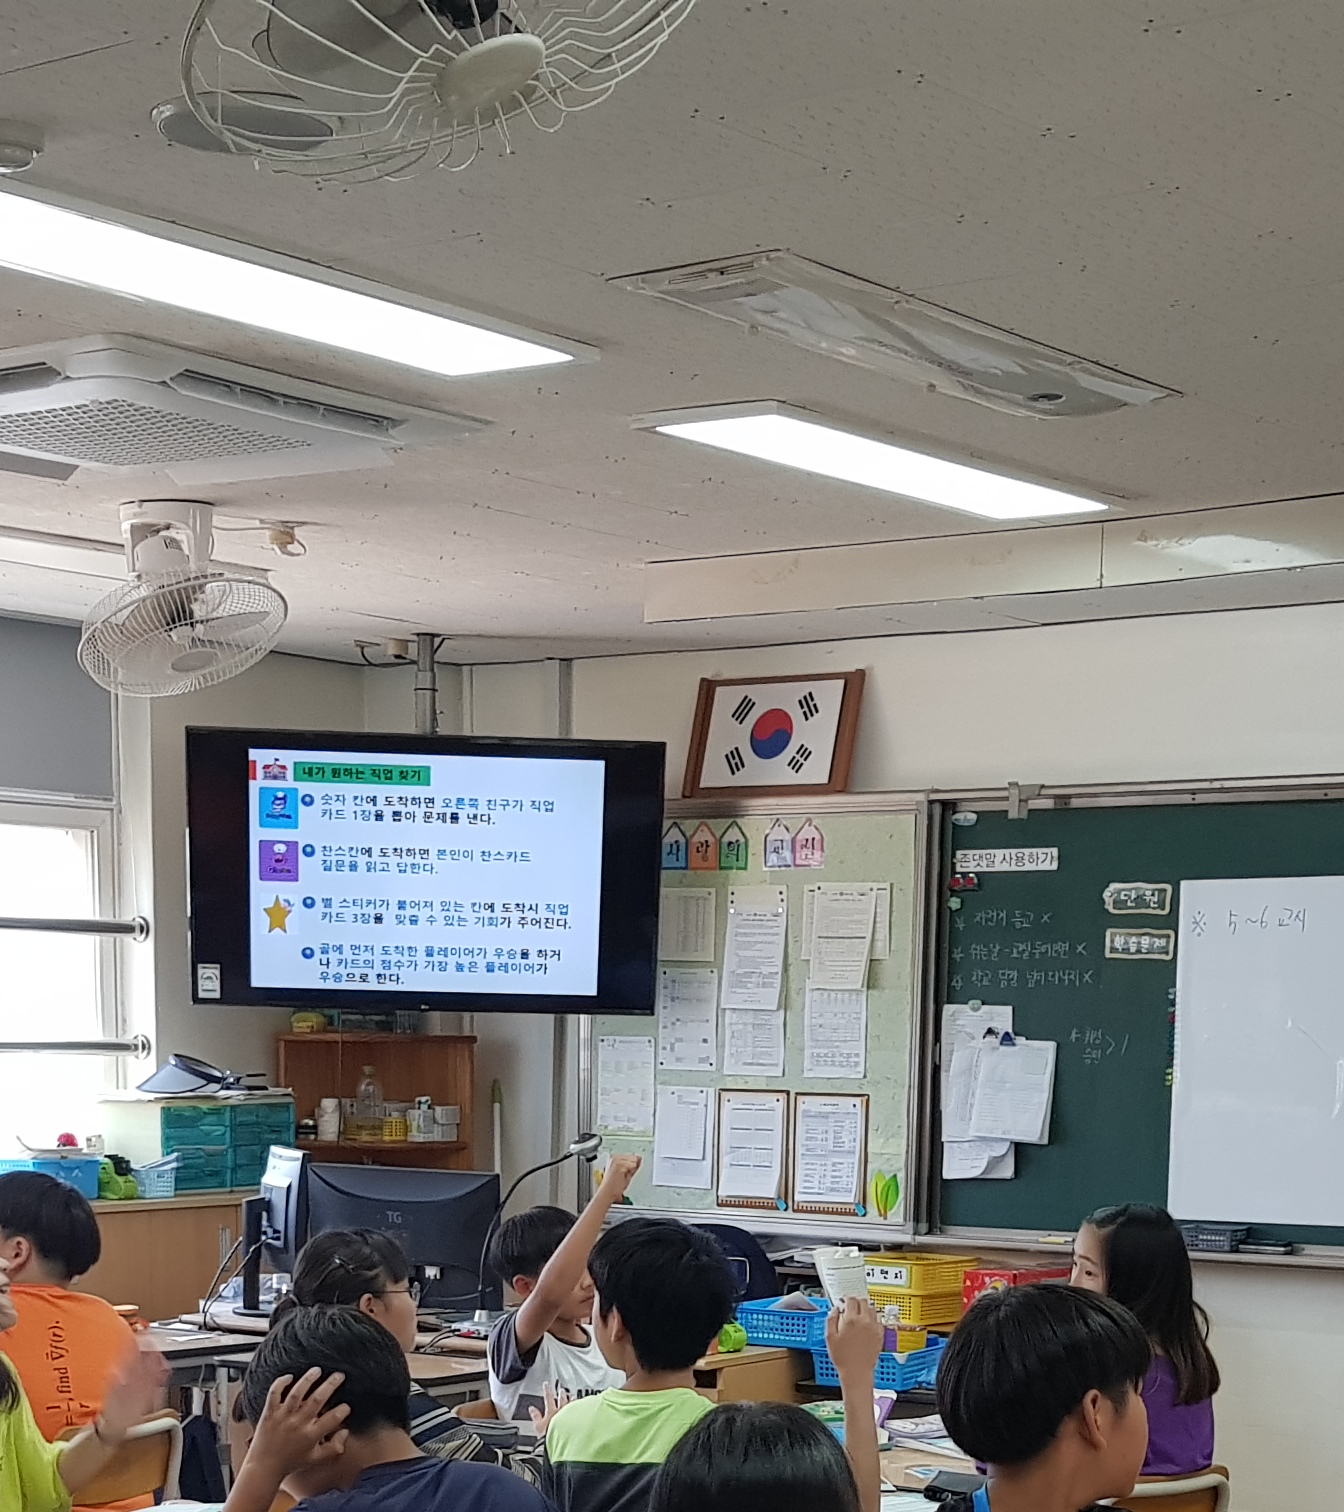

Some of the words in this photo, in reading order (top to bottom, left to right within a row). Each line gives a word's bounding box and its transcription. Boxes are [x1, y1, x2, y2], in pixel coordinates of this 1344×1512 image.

[303, 767, 326, 778] 내가
[331, 767, 365, 780] 원하는
[370, 768, 393, 781] 직업
[399, 769, 421, 782] 찾기
[321, 793, 346, 806] 숫자
[352, 794, 377, 807] 칸에
[383, 796, 435, 808] 도착하면
[441, 797, 479, 810] 오른쪽
[486, 799, 524, 812] 친구가
[530, 800, 554, 813] 직업
[321, 809, 346, 821] 카드
[353, 809, 385, 822] 1장을
[391, 810, 416, 823] 뽑아
[423, 811, 460, 824] 문제를
[467, 813, 496, 825] 낸다.
[321, 846, 372, 858] 찬스칸에
[378, 847, 430, 860] 도착하면
[436, 849, 474, 861] 본인이
[480, 850, 531, 862] 찬스카드
[959, 853, 996, 869] 존댓말
[321, 860, 359, 872] 질문을
[366, 861, 390, 873] 읽고
[397, 861, 438, 875] 답한다.
[321, 897, 333, 909] 별
[338, 898, 390, 910] 스티커가
[440, 900, 465, 913] 있는
[471, 902, 495, 914] 칸에
[501, 902, 539, 915] 도착시
[544, 903, 569, 916] 직업
[1120, 890, 1159, 907] 단원
[321, 912, 346, 923] 카드
[352, 912, 384, 925] 3장을
[425, 914, 437, 926] 수
[443, 915, 469, 927] 있는
[474, 916, 512, 928] 기회가
[517, 917, 572, 930] 주어진다.
[1278, 908, 1306, 933] 교시
[319, 943, 344, 955] 골에
[350, 944, 375, 956] 먼저
[380, 945, 417, 957] 도착한
[425, 946, 487, 959] 플레이어가
[493, 948, 531, 960] 우승을
[537, 949, 561, 961] 하거
[320, 958, 331, 968] 나
[337, 958, 375, 970] 카드의
[381, 959, 419, 971] 점수가
[455, 961, 479, 973] 높은
[485, 962, 548, 975] 플레이어가
[319, 972, 371, 984] 우승으로
[376, 973, 405, 985] 한다.
[386, 1211, 402, 1223] TG
[57, 1366, 72, 1394] find
